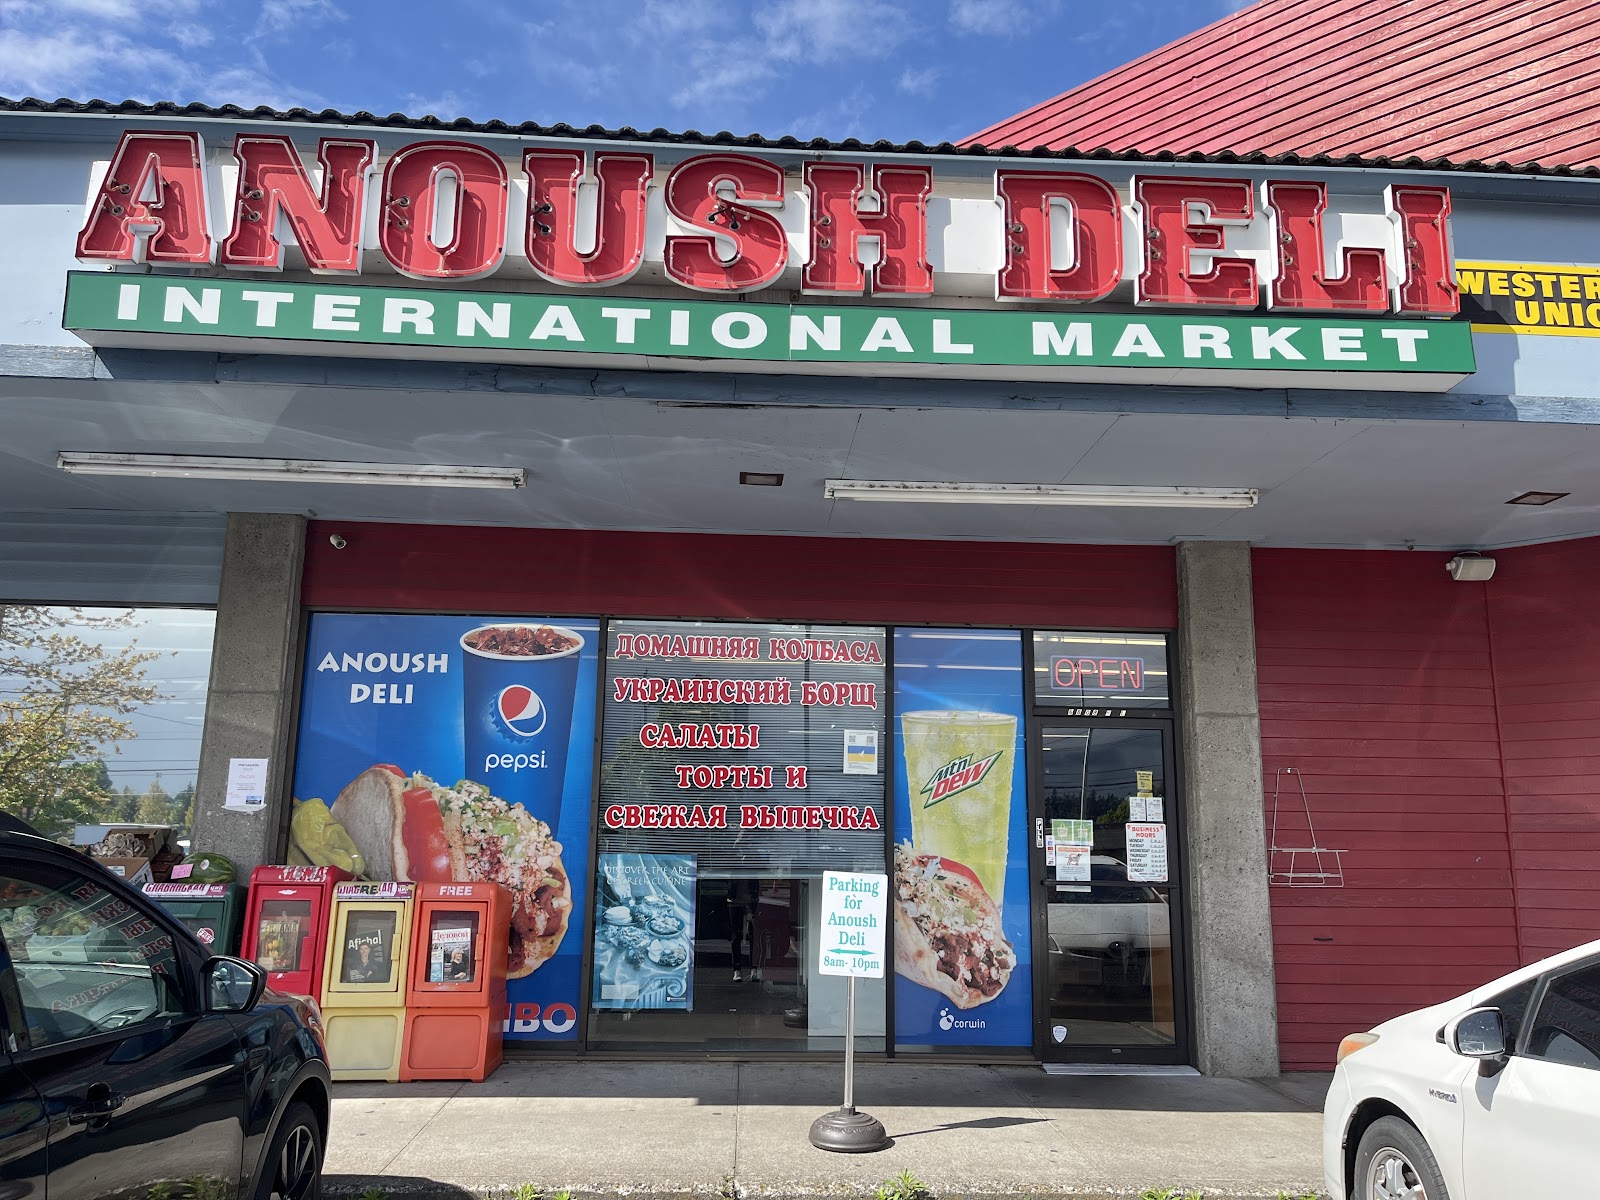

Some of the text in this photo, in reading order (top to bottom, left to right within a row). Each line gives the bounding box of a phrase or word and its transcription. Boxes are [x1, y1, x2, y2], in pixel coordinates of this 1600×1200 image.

[76, 129, 1461, 316] ANOUSH DELI
[116, 283, 1429, 363] INTERNATIONAL MARKET
[615, 634, 882, 664] ДОМАШНЯЯ КОЛБАСА
[317, 652, 448, 673] ANOUSH
[1055, 658, 1140, 689] OPEN
[350, 684, 414, 704] DELI
[614, 677, 877, 709] УКРАИНСКИЙ БОРЩ
[640, 723, 760, 749] САЛАТЫ
[485, 750, 546, 773] pepsi
[675, 765, 808, 789] ТОРТЫ И
[605, 804, 881, 830] СВЕЖАЯ ВЫПЕЧКА
[606, 866, 690, 875] DIOVER THE ART
[439, 885, 473, 896] FREE
[829, 877, 880, 898] Parking
[844, 895, 863, 910] for
[828, 912, 877, 928] Anoush
[198, 928, 215, 943] FREE
[839, 931, 865, 946] Deli
[852, 957, 880, 971] 10pm
[954, 1018, 986, 1029] corwin
